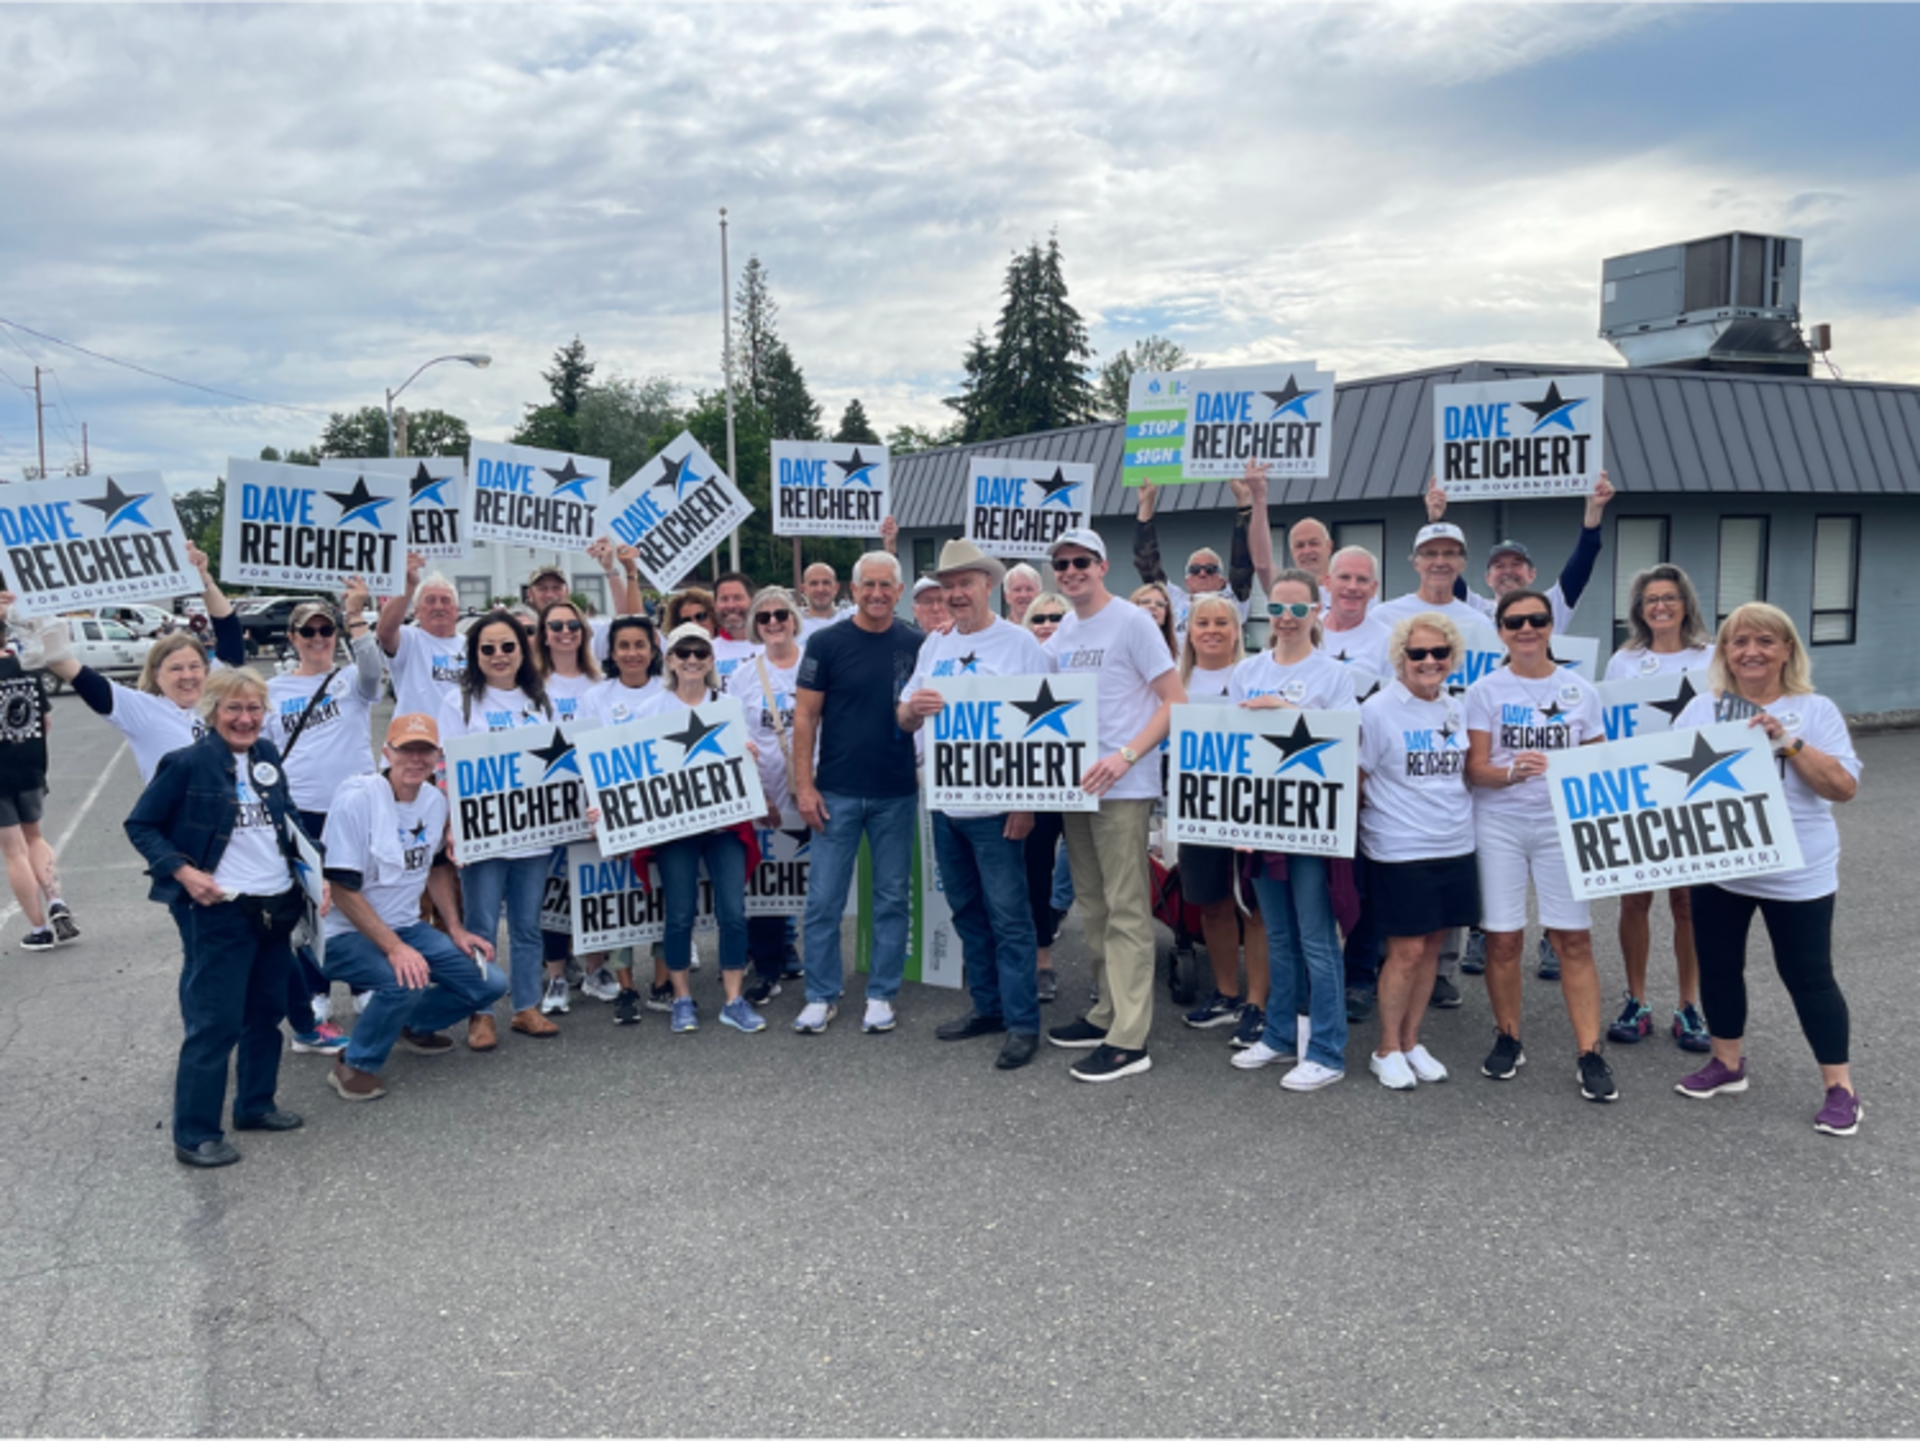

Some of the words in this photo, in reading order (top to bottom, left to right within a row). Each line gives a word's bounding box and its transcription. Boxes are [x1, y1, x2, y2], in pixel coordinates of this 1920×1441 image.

[1195, 391, 1254, 422] DAVE
[1444, 402, 1511, 441] DAVE
[1138, 419, 1178, 436] STOP
[1192, 422, 1321, 459] REICHERT
[779, 458, 828, 487] DAVE
[1134, 447, 1173, 464] SIGN
[1444, 434, 1591, 481] REICHERT
[477, 458, 535, 494] DAVE
[975, 476, 1027, 507] DAVE
[0, 501, 82, 546] DAVE
[242, 483, 316, 525] DAVE
[473, 488, 597, 538] REICHERT
[610, 488, 668, 546] DAVE
[780, 487, 883, 521] REICHERT
[635, 474, 733, 574] REICHERT
[973, 507, 1083, 543] REICHERT
[8, 530, 180, 593] REICHERT
[240, 521, 397, 574] REICHERT
[934, 701, 1003, 740] DAVE
[1502, 703, 1534, 726] DAVE
[1180, 730, 1254, 774] DAVE
[1404, 729, 1435, 751] DAVE
[1501, 724, 1571, 750] REICHERT
[456, 751, 524, 798] DAVE
[589, 738, 664, 789] DAVE
[935, 741, 1086, 788] REICHERT
[598, 756, 747, 832] REICHERT
[935, 791, 963, 800] FOR
[1179, 772, 1344, 831] REICHERT
[1561, 764, 1657, 820] DAVE
[1177, 823, 1206, 834] FOR
[1571, 793, 1774, 873] REICHERT
[1583, 874, 1620, 887] FOR
[1635, 849, 1780, 881] GOVERNOR(R)
